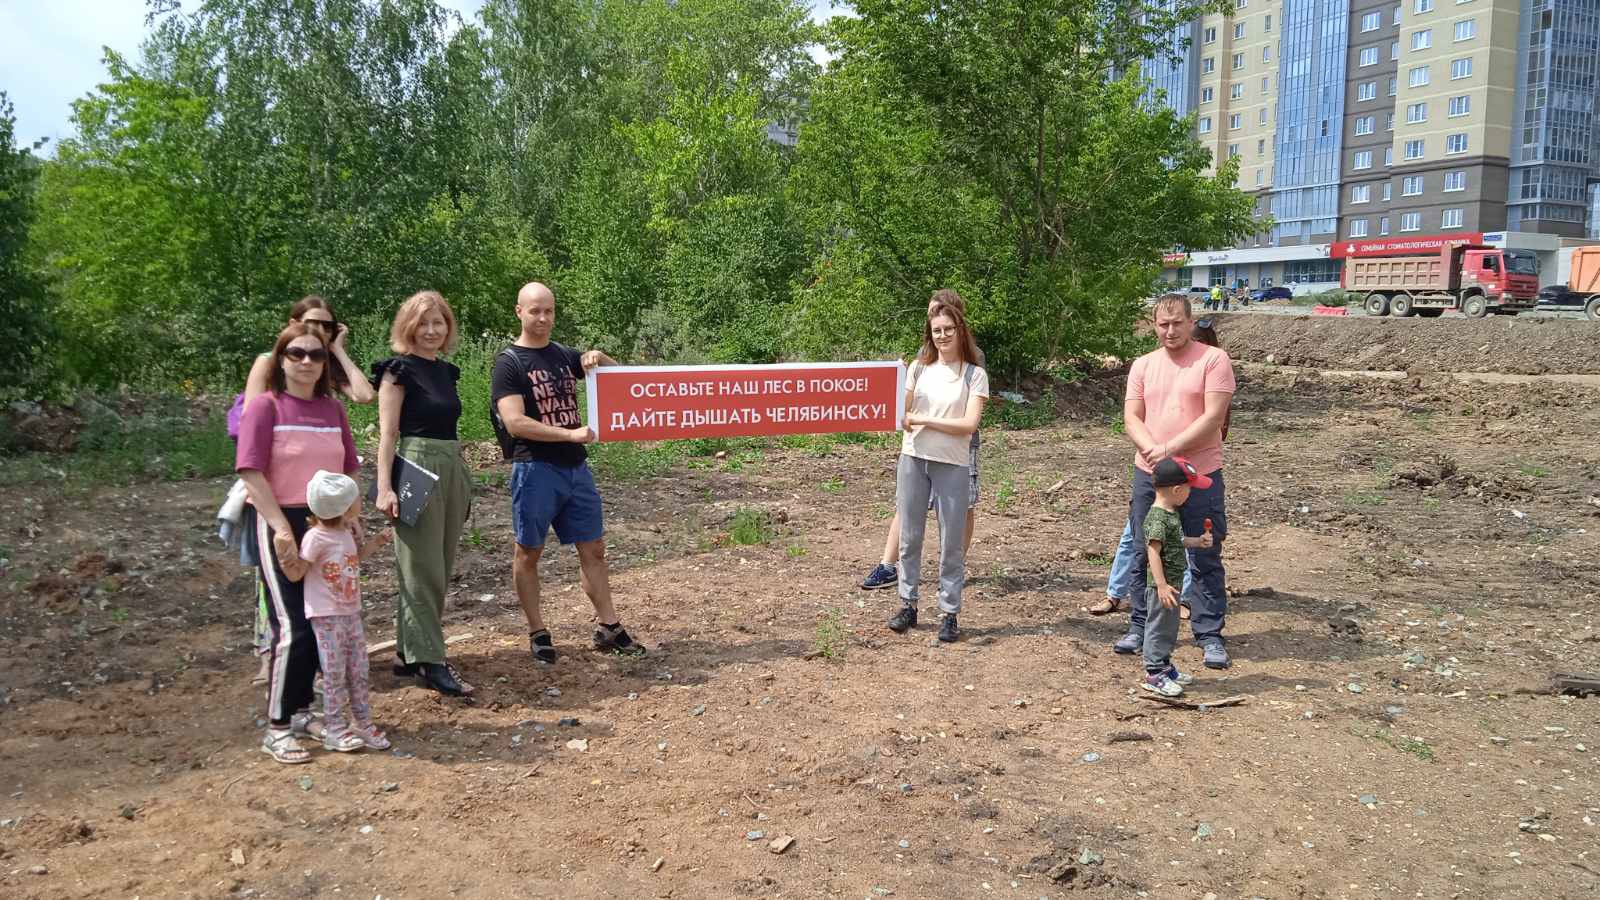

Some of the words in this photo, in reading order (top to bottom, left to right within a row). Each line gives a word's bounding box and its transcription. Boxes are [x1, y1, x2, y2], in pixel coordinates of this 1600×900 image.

[630, 381, 715, 398] ОСТАВЬТЕ
[718, 379, 759, 396] НАШ
[762, 379, 793, 395] ЛЕС
[796, 379, 806, 393] В
[809, 377, 869, 393] ПОКОЕ!
[535, 395, 577, 414] WALK
[610, 407, 676, 431] ДАЙТЕ
[680, 407, 761, 428] ДЫШАТЬ
[766, 403, 887, 424] ЧЕЛЯБИНСКУ!
